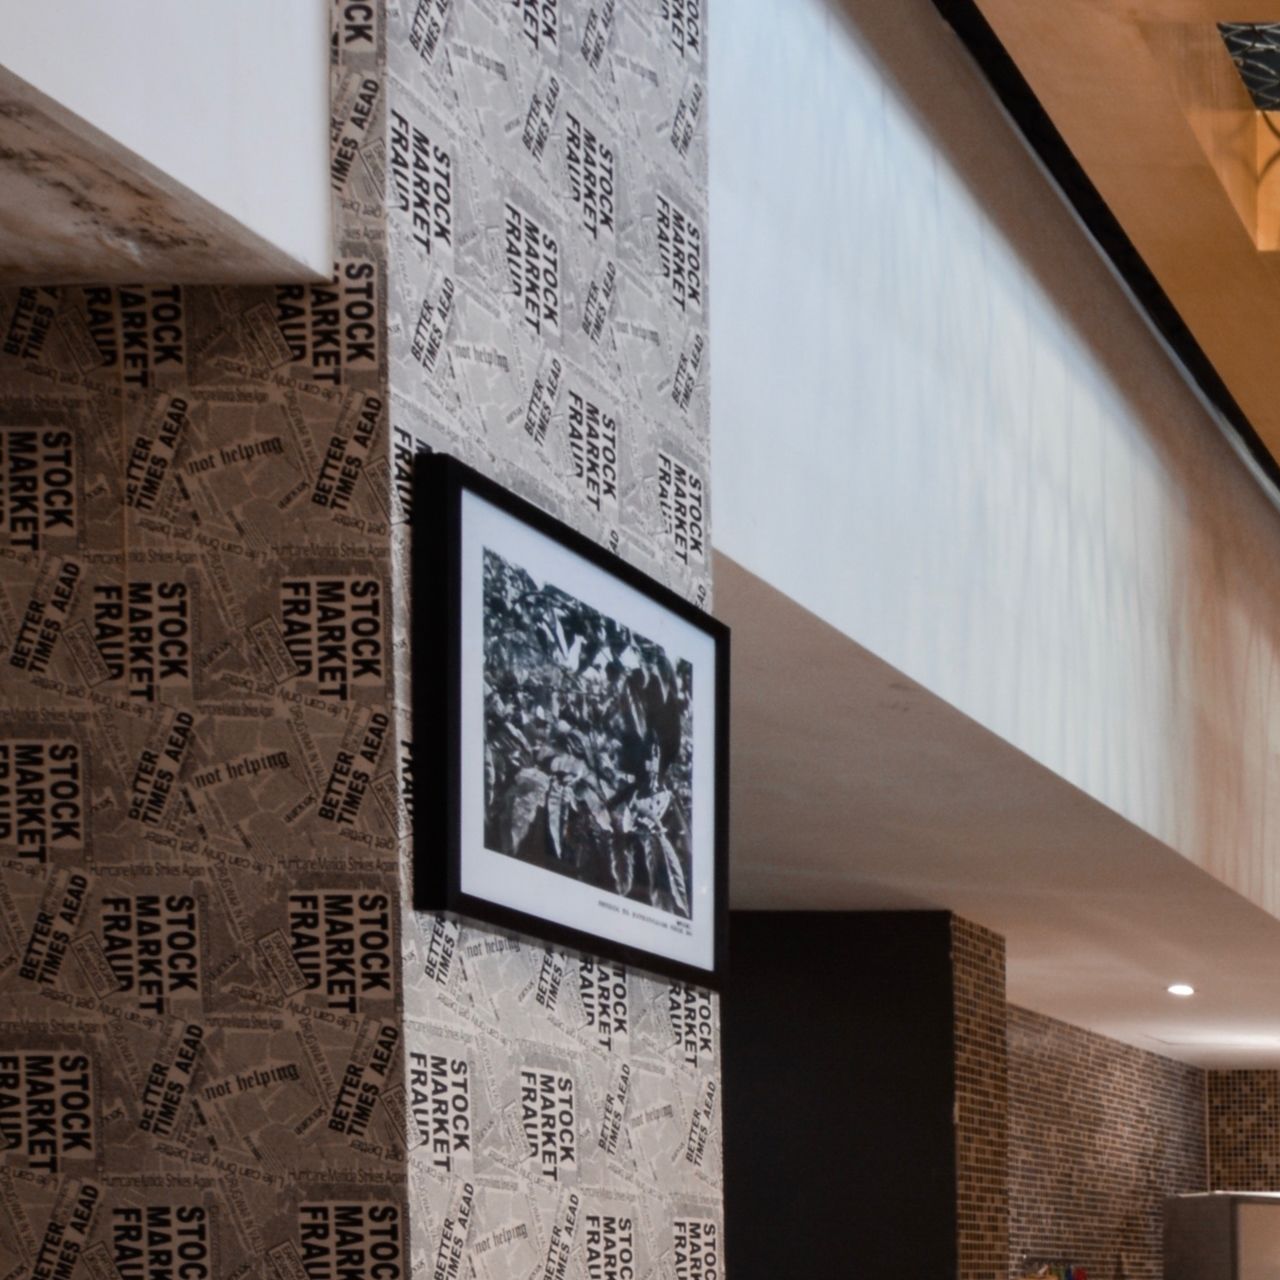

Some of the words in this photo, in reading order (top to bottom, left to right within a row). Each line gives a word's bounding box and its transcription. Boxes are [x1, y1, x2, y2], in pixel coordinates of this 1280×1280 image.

[391, 108, 410, 212] FRAUD
[522, 94, 542, 154] BETTER
[528, 118, 550, 163] TIMES
[412, 126, 431, 254] MARKET
[433, 146, 452, 246] STOCK
[505, 202, 522, 297] FRAUD
[524, 218, 540, 335] MARKET
[542, 234, 559, 328] STOCK
[410, 299, 431, 362] BETTER
[422, 324, 443, 374] TIMES
[437, 278, 454, 320] AEAD
[43, 432, 73, 528] STOCK
[190, 453, 215, 476] not
[220, 437, 284, 464] helping
[312, 437, 347, 507] BETTER
[330, 456, 362, 512] TIMES
[356, 397, 381, 448] AEAD
[568, 390, 583, 478] FRAUD
[586, 402, 599, 511] MARKET
[602, 414, 616, 500] STOCK
[8, 432, 39, 551] MARKET
[282, 582, 311, 677] FRAUD
[316, 581, 347, 700] MARKET
[350, 581, 381, 679] STOCK
[195, 768, 220, 789] not
[226, 751, 290, 779] helping
[20, 912, 52, 980] BETTER
[37, 930, 70, 986] TIMES
[62, 875, 88, 925] AEAD
[329, 1064, 364, 1132] BETTER
[346, 1082, 379, 1137] TIMES
[373, 1026, 399, 1076] AEAD
[599, 1095, 614, 1151] BETTER
[607, 1110, 622, 1156] TIMES
[618, 1064, 630, 1104] AEAD
[460, 1183, 475, 1229] AEAD
[475, 1236, 491, 1253] not
[493, 1224, 528, 1246] helping
